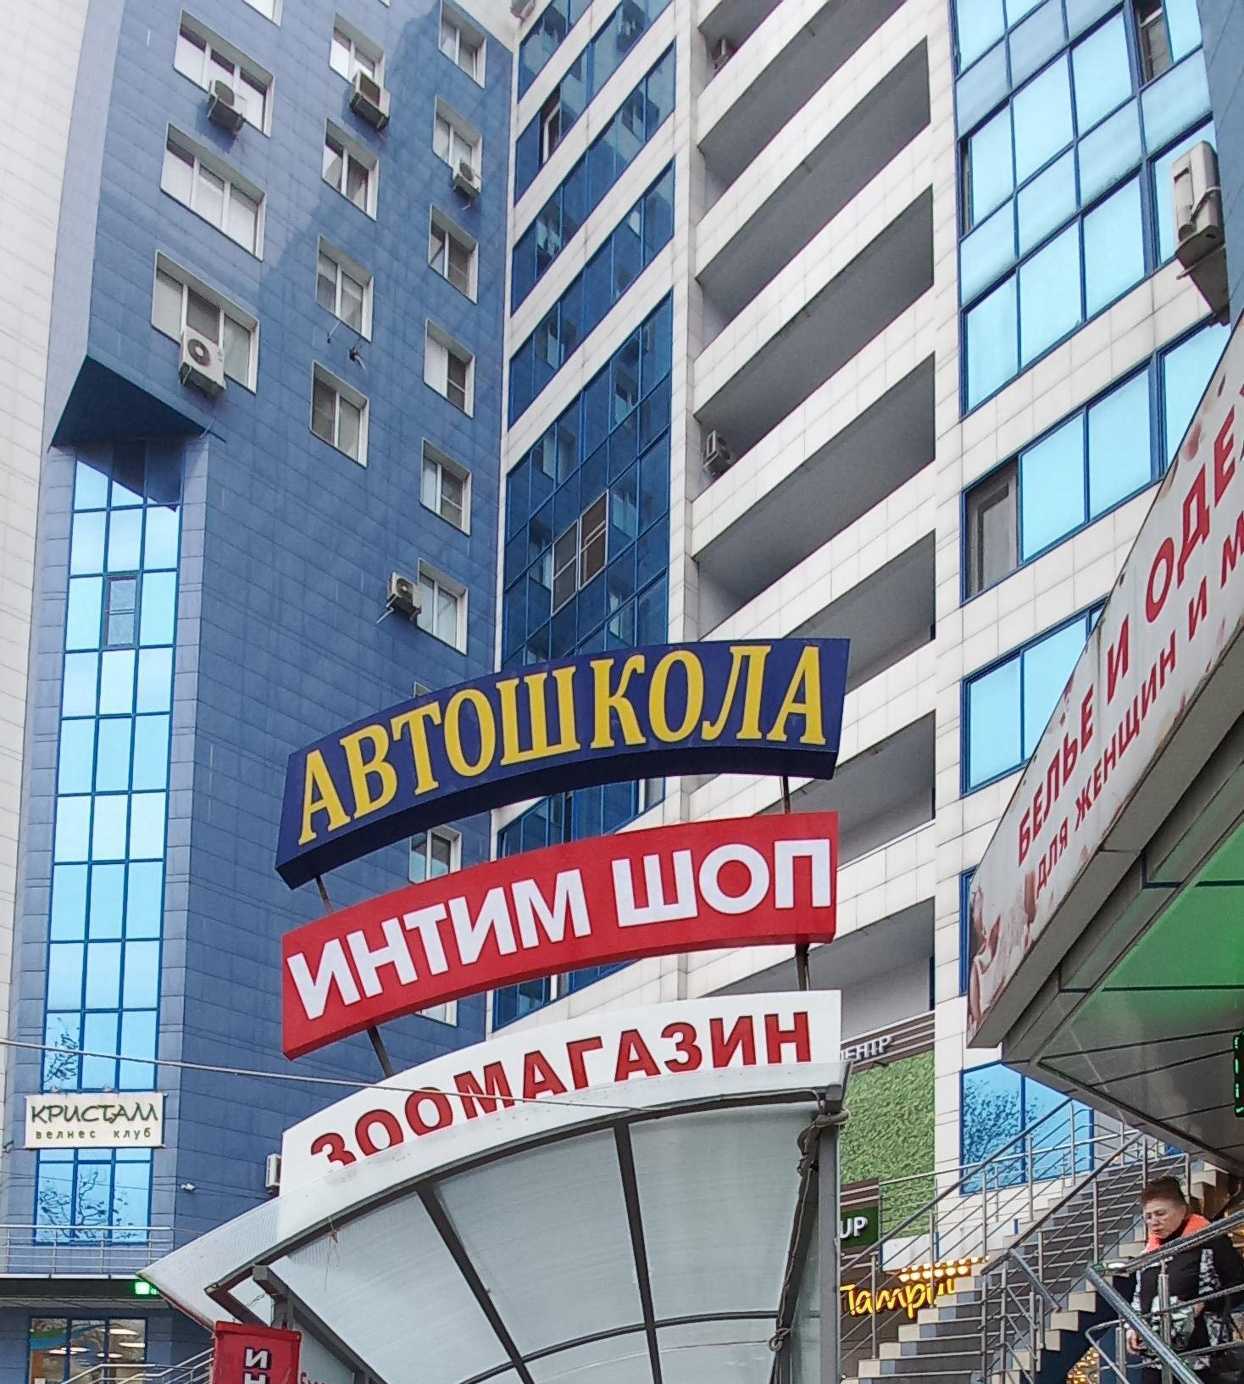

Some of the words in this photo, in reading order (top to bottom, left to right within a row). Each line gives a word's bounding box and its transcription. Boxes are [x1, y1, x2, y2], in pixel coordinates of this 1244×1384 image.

[1019, 685, 1093, 867] БЕЛЬЕ
[1107, 614, 1129, 705] И
[1146, 384, 1244, 623] ОДЕ
[297, 644, 828, 846] АВТОШКОЛА
[1036, 817, 1068, 899] ДЛЯ
[1075, 630, 1176, 832] ЖЕНЩИН
[1189, 576, 1207, 642] И
[286, 868, 592, 1020] ИНТИМ
[611, 838, 832, 929] ШОП
[36, 1129, 96, 1140] велнес
[113, 1127, 151, 1141] клуб
[310, 1010, 813, 1167] ЗООМАГАЗИН
